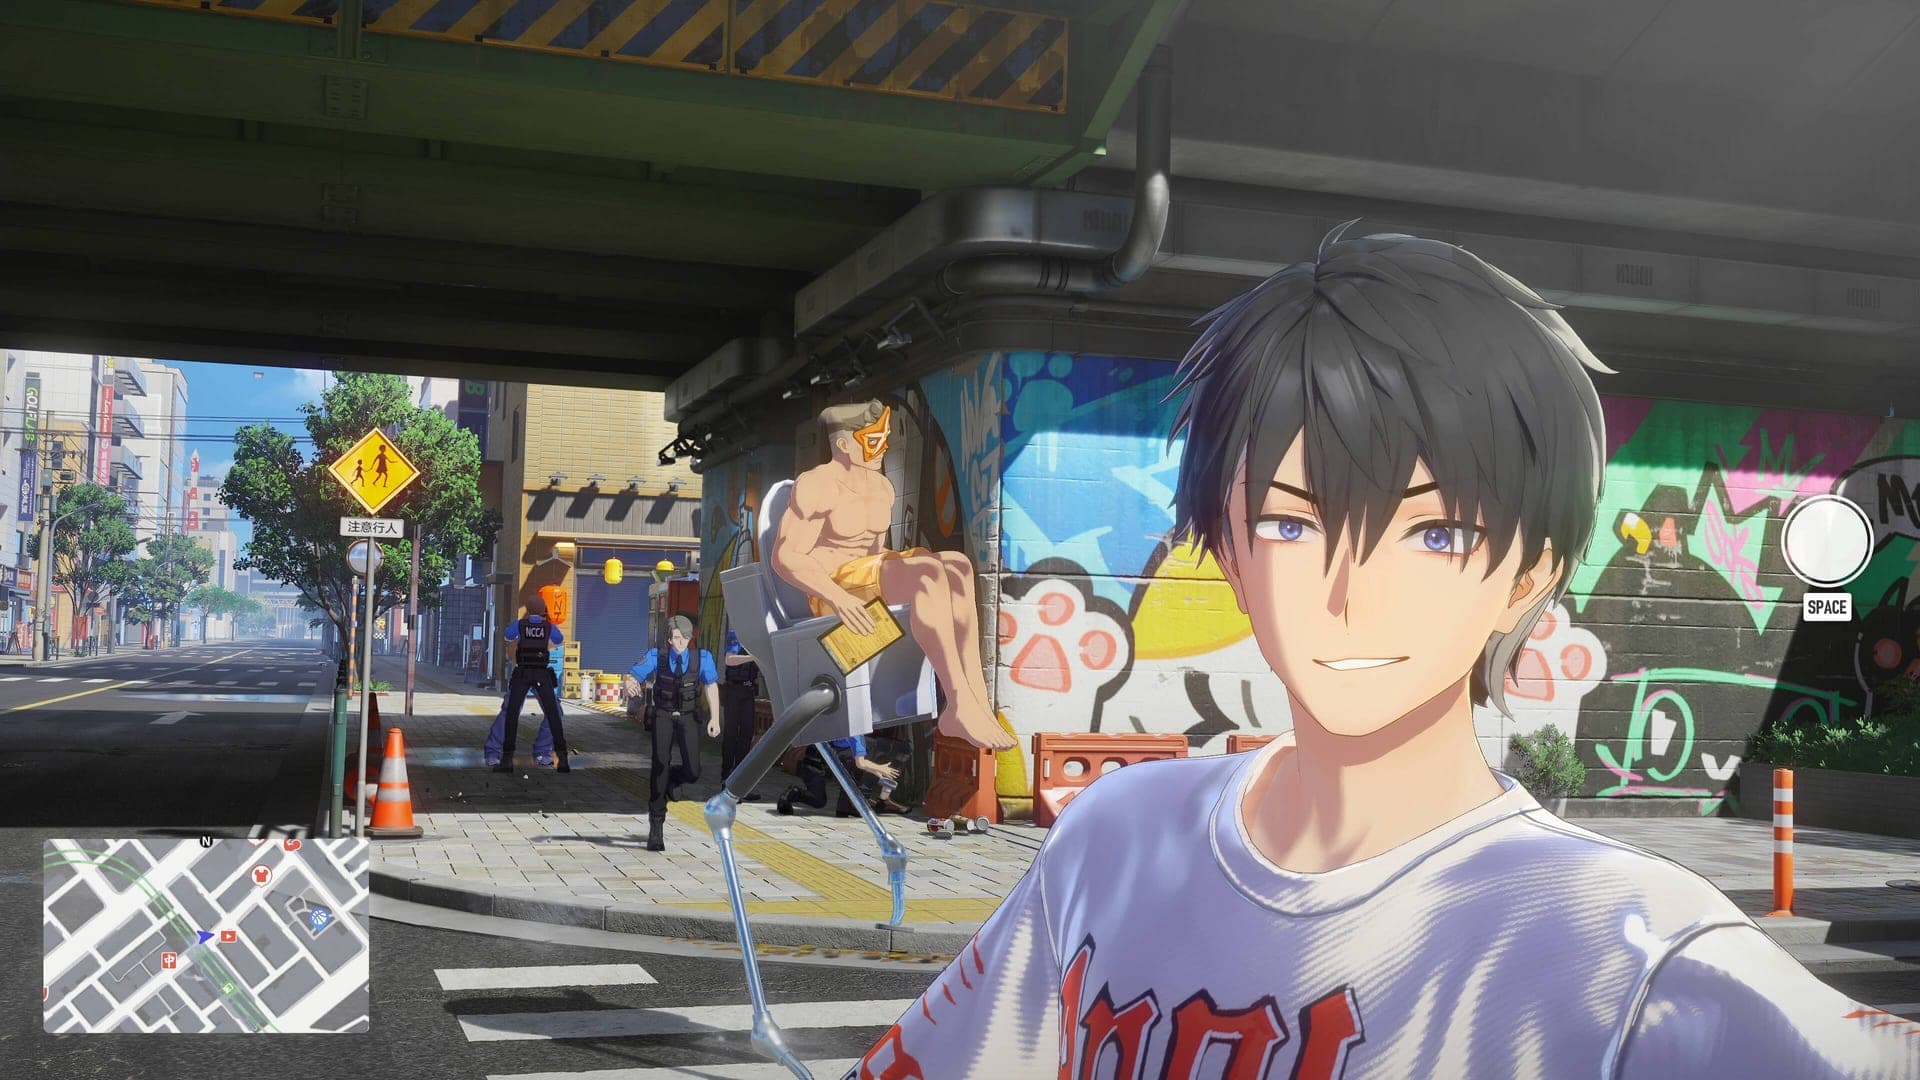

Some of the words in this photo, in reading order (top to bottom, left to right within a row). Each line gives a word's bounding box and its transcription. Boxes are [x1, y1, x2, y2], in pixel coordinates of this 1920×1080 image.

[348, 521, 397, 534] 注意行人
[525, 627, 544, 637] NCCA
